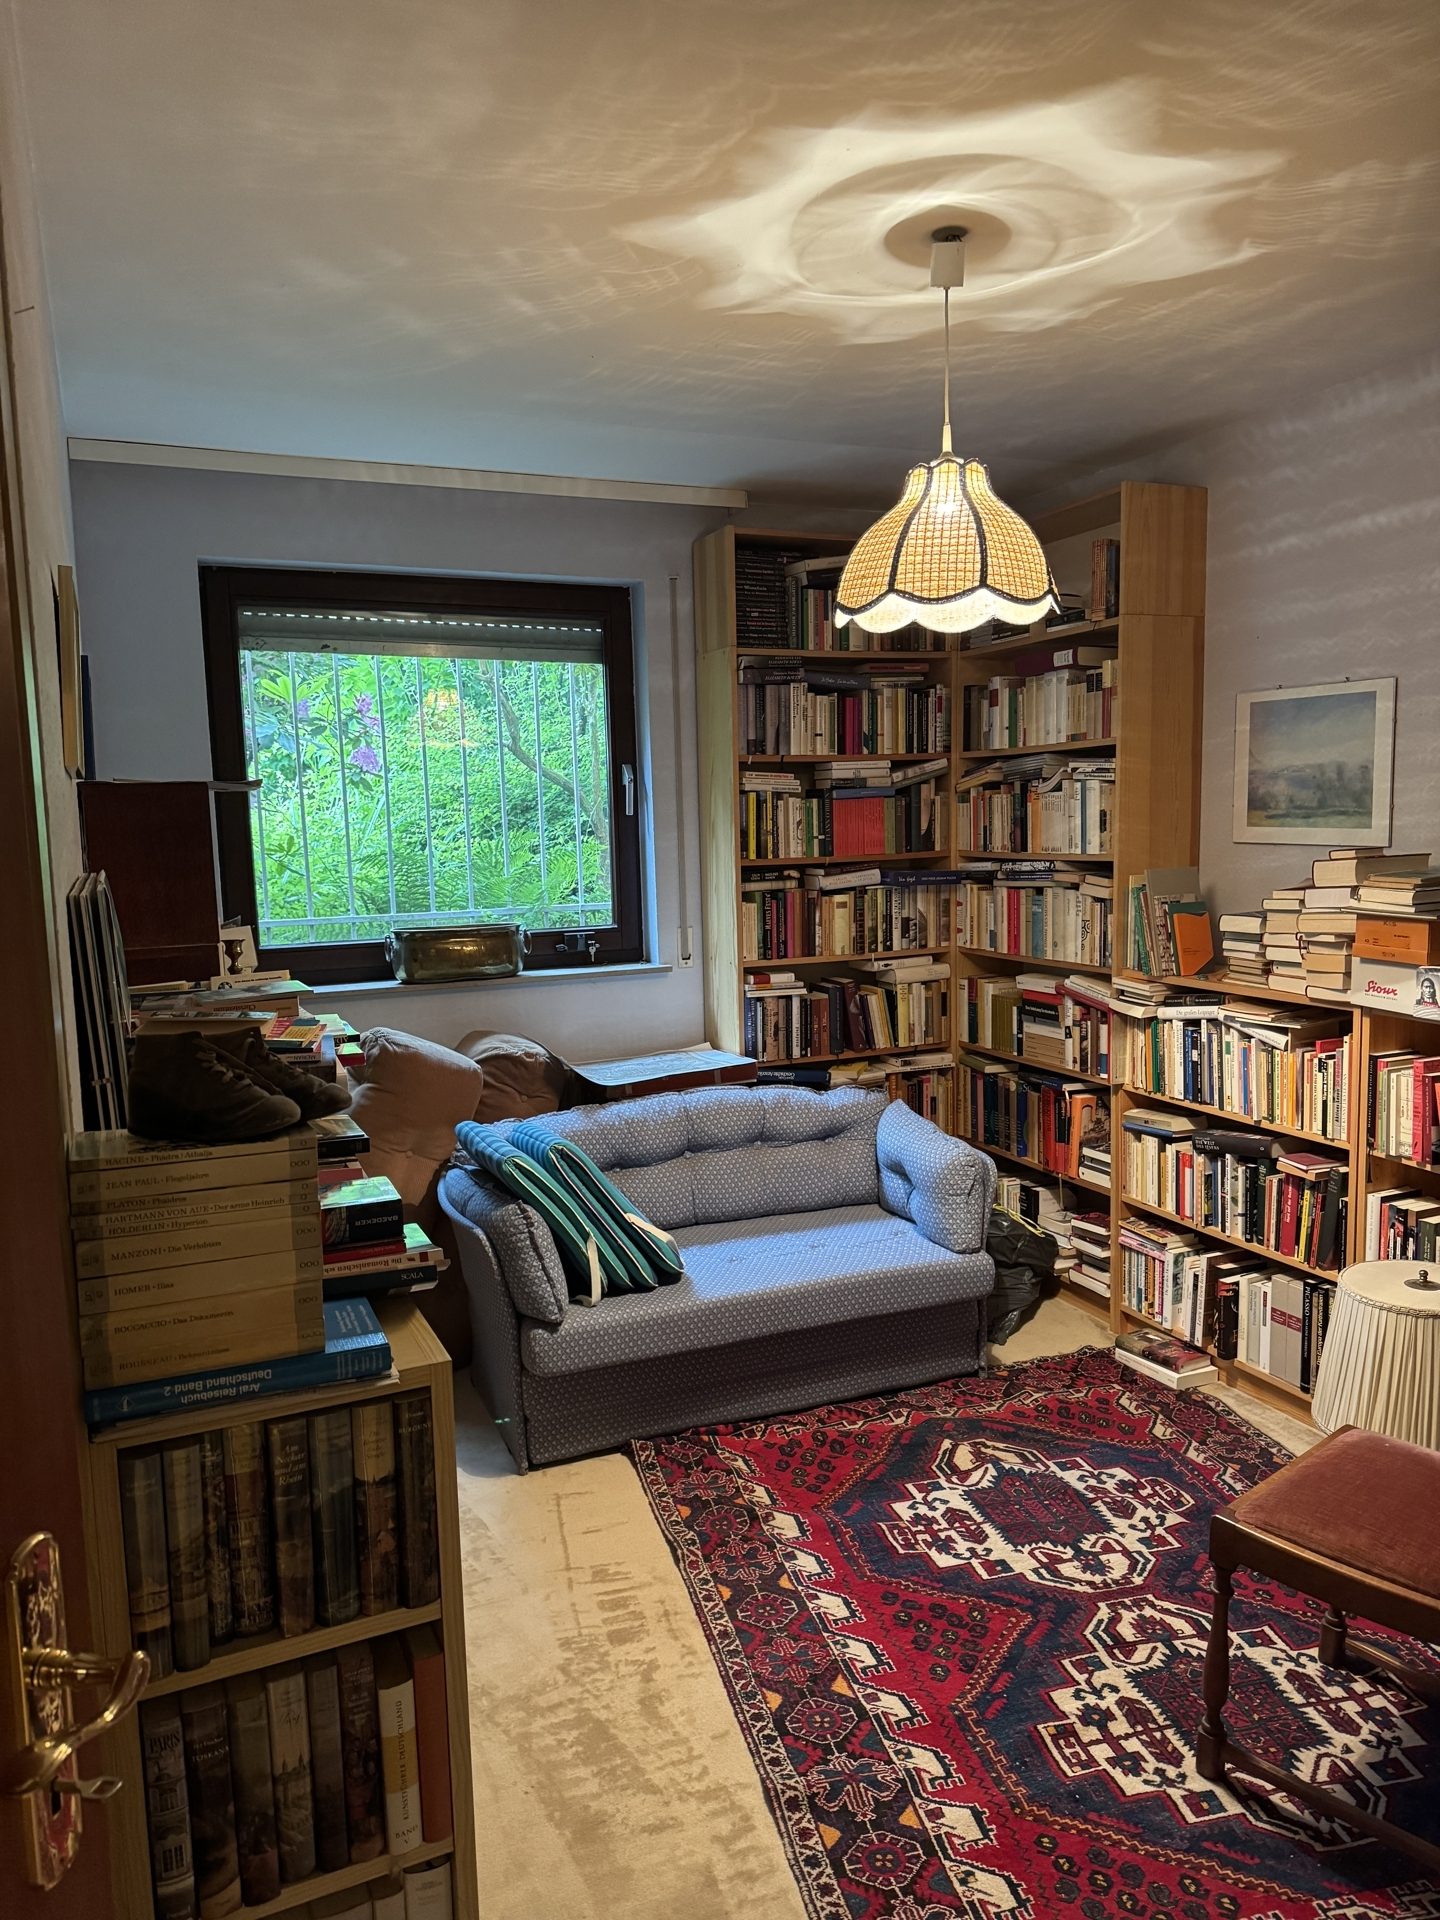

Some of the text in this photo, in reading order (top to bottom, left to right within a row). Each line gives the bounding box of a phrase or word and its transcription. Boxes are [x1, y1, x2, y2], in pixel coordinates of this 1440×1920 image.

[1364, 980, 1398, 996] Sioux
[106, 1179, 133, 1191] JEAN
[134, 1176, 161, 1187] PAUL
[105, 1209, 165, 1224] HARTMANN
[166, 1207, 188, 1219] VON
[189, 1206, 210, 1216] AUE
[250, 1197, 286, 1208] Heinrich
[106, 1199, 147, 1210] PLATON
[169, 1217, 209, 1231] Hyperion
[355, 1215, 399, 1227] BAEDEKER
[110, 1246, 162, 1262] MANZONI
[167, 1243, 182, 1254] Die
[390, 1257, 402, 1265] Die
[324, 1266, 336, 1275] sch
[400, 1271, 424, 1281] SCALA
[113, 1283, 151, 1297] HOMER
[113, 1319, 168, 1335] BOCCACCIO
[163, 1368, 273, 1398] Deutschland Band 2
[180, 1382, 261, 1405] Aral Reisebuch
[149, 1731, 181, 1755] PARIS
